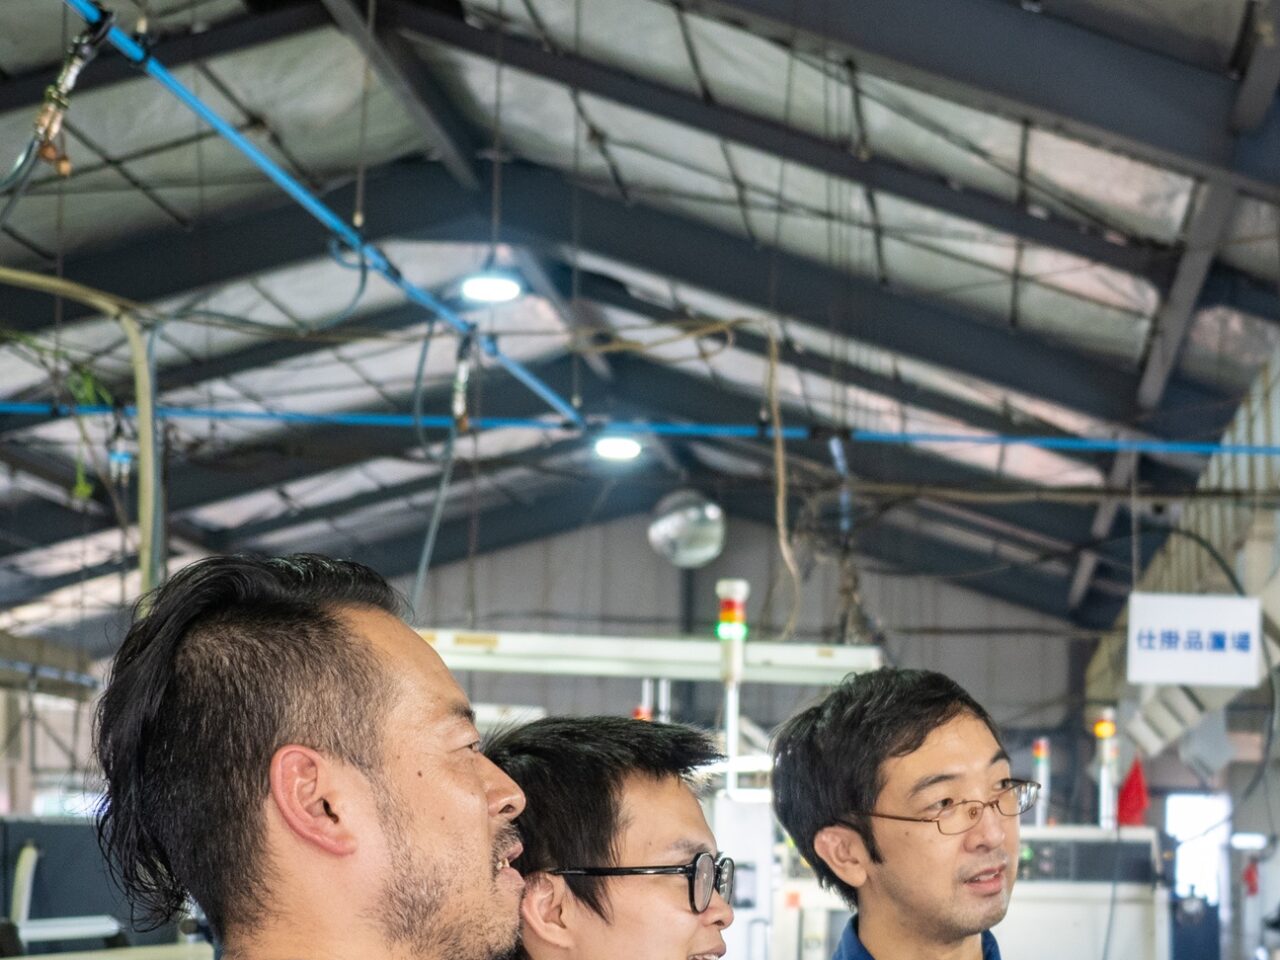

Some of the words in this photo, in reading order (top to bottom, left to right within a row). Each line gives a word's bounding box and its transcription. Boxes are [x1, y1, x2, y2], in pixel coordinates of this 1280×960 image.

[1137, 627, 1250, 653] 仕掛品置場
